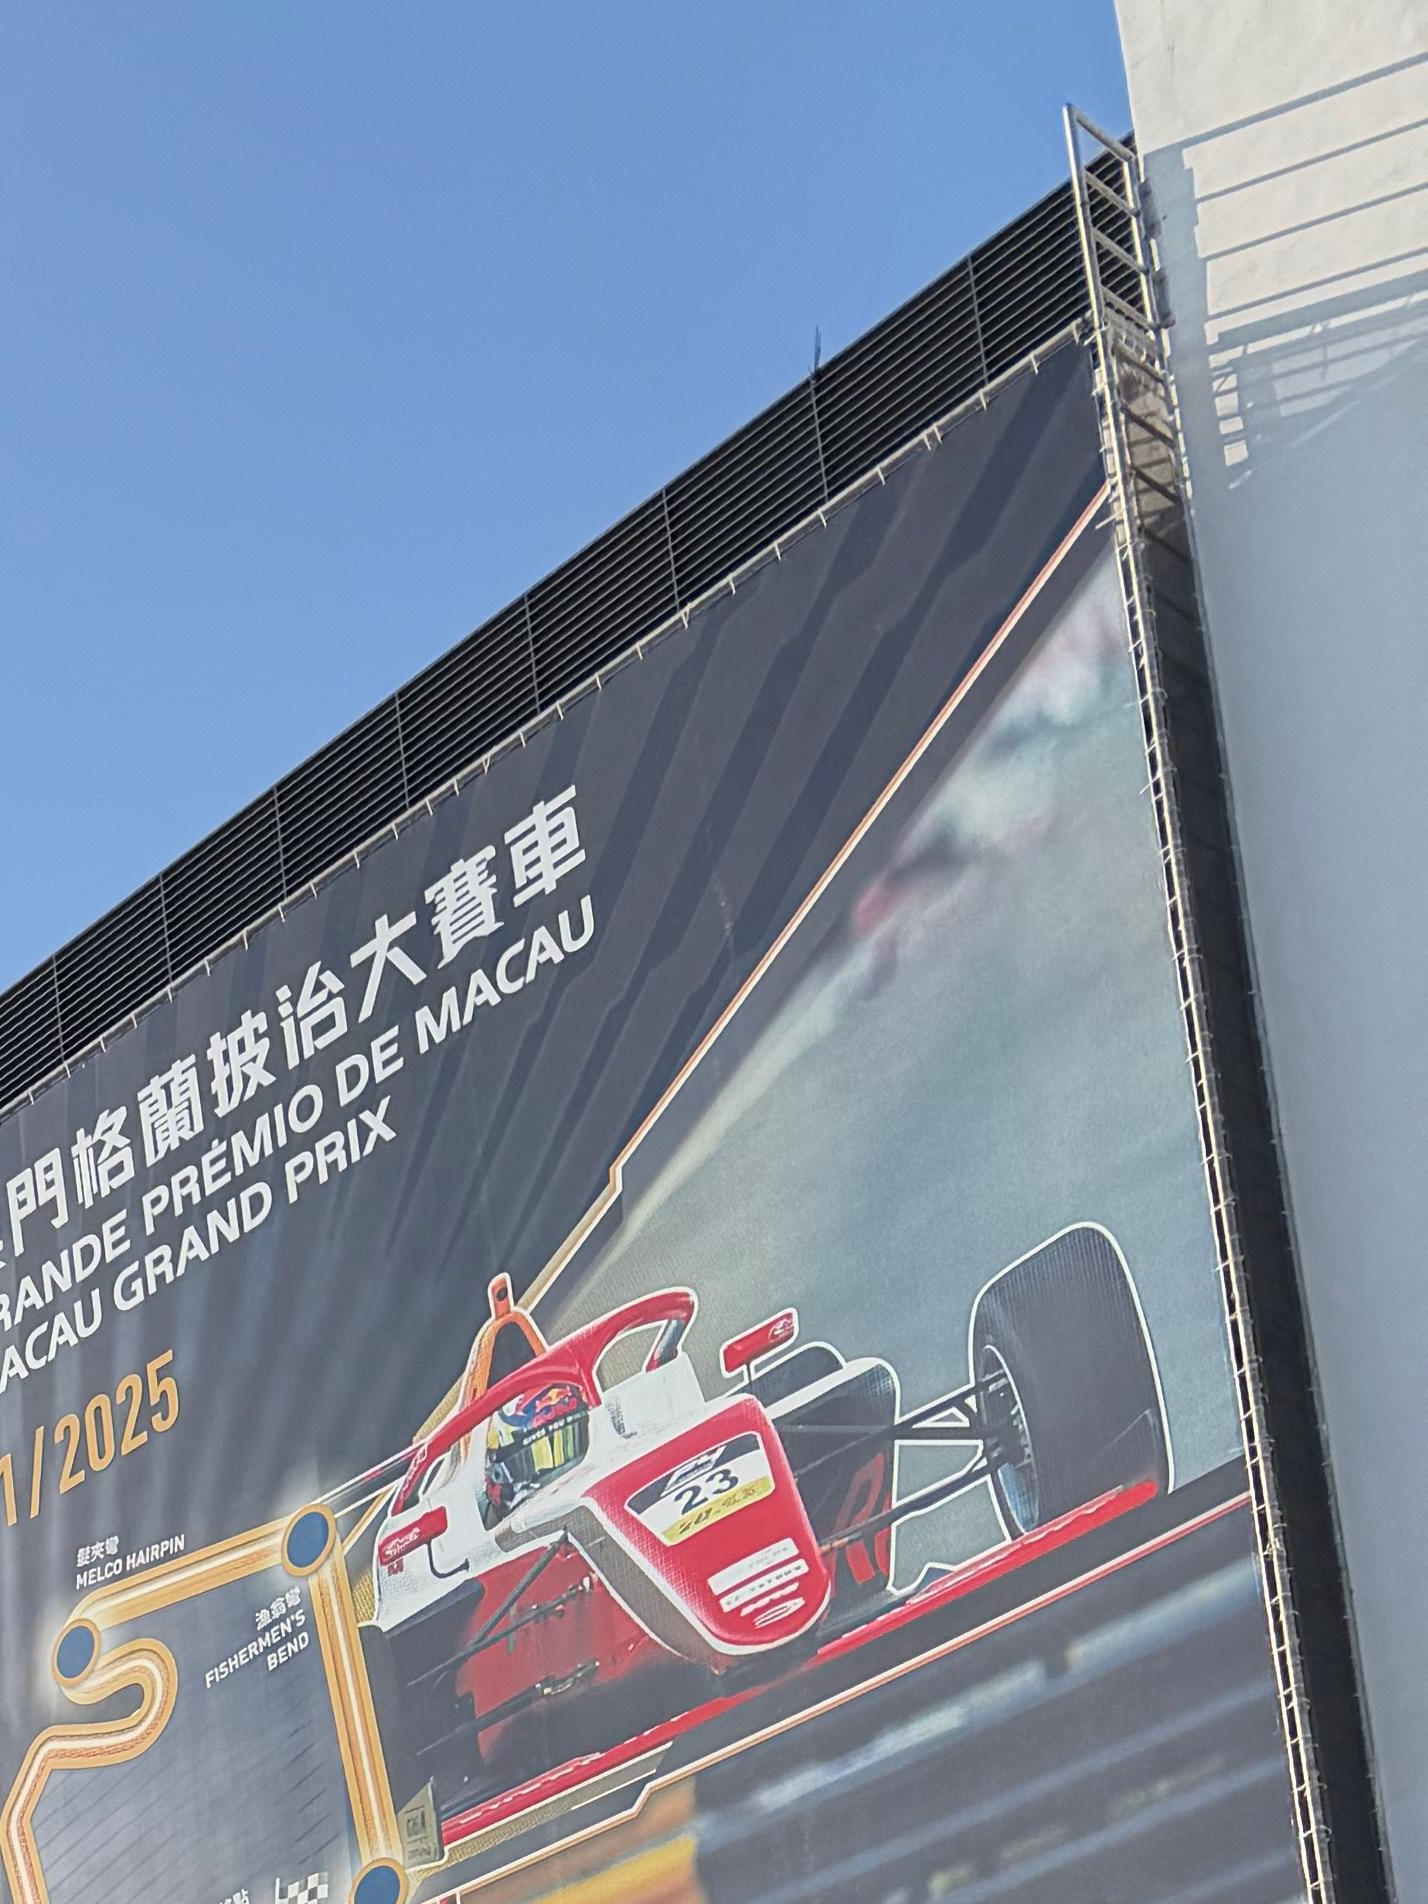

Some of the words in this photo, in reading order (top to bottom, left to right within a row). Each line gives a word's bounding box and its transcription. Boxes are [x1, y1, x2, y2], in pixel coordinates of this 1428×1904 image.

[142, 1084, 323, 1237] PRÉMIO
[336, 1026, 405, 1108] DE
[417, 895, 596, 1055] MACAU
[113, 1186, 273, 1311] GRAND
[285, 1097, 397, 1204] PRIX
[673, 1468, 739, 1515] 23
[76, 1557, 123, 1590] MELCO
[126, 1534, 185, 1571] HAIRPIN
[204, 1609, 306, 1688] FISHERMEN'S
[266, 1632, 309, 1672] BEND
